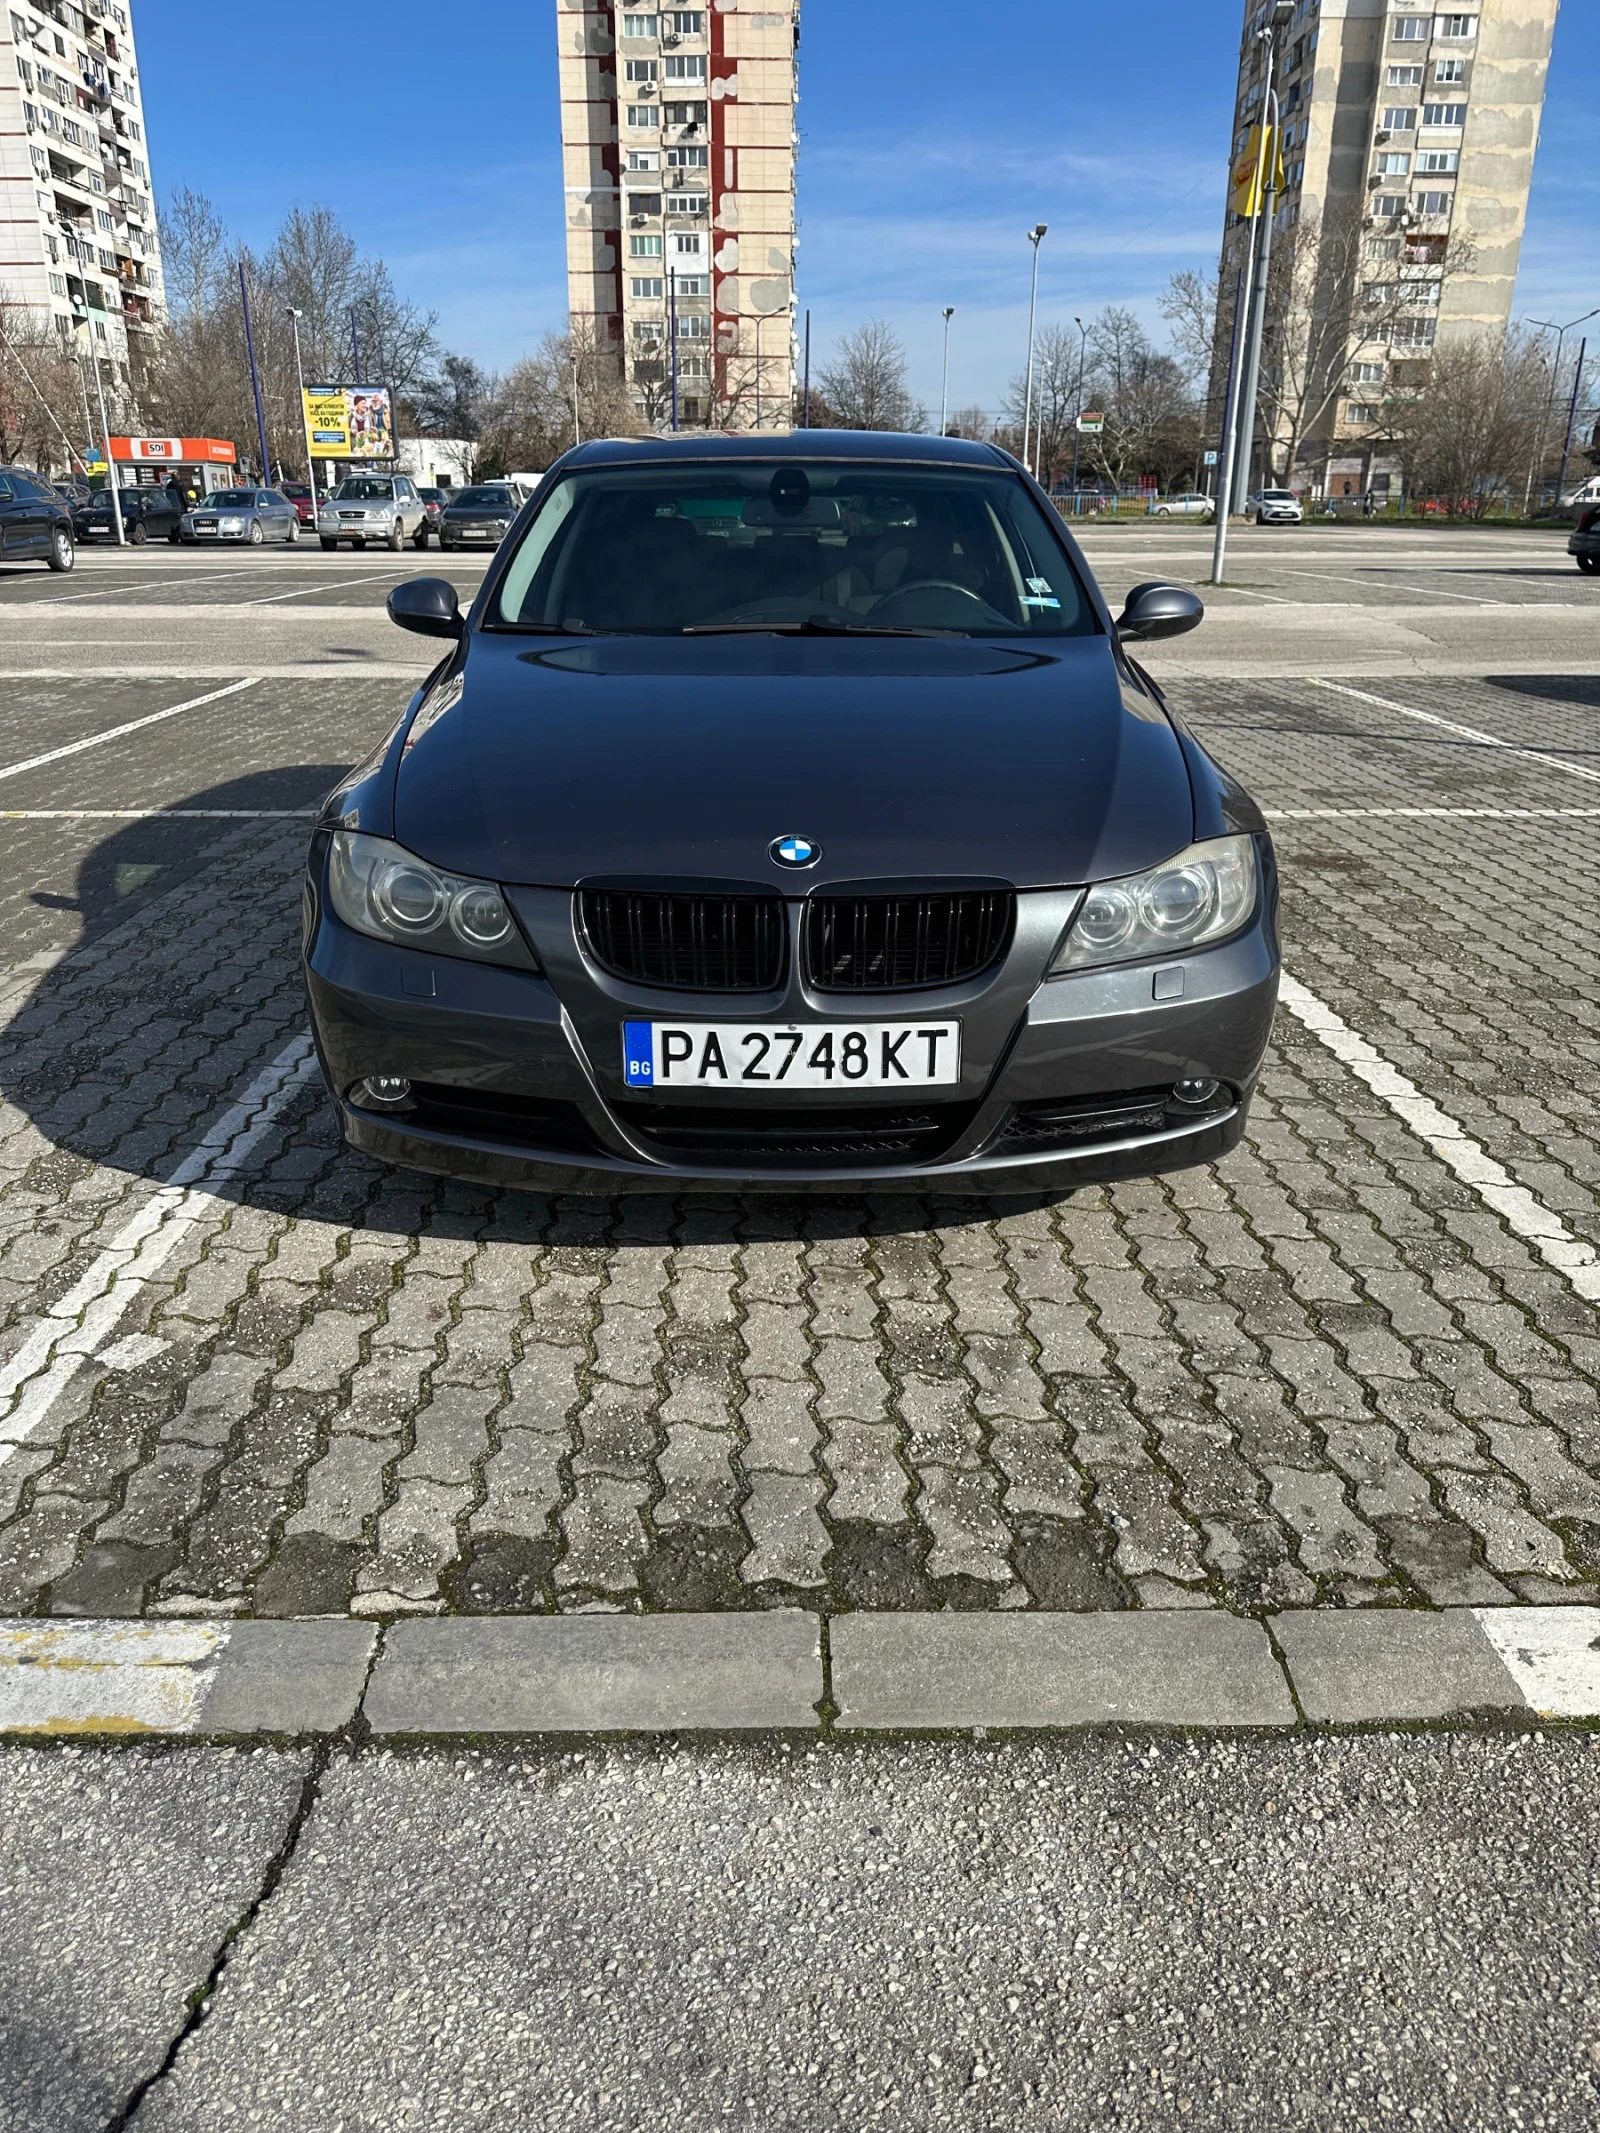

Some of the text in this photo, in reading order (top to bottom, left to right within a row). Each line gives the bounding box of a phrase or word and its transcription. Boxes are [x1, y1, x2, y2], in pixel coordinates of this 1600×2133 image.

[315, 417, 341, 427] -10%
[149, 444, 164, 452] SDI
[661, 1029, 949, 1081] PA 2748 KT
[629, 1060, 651, 1076] BG
